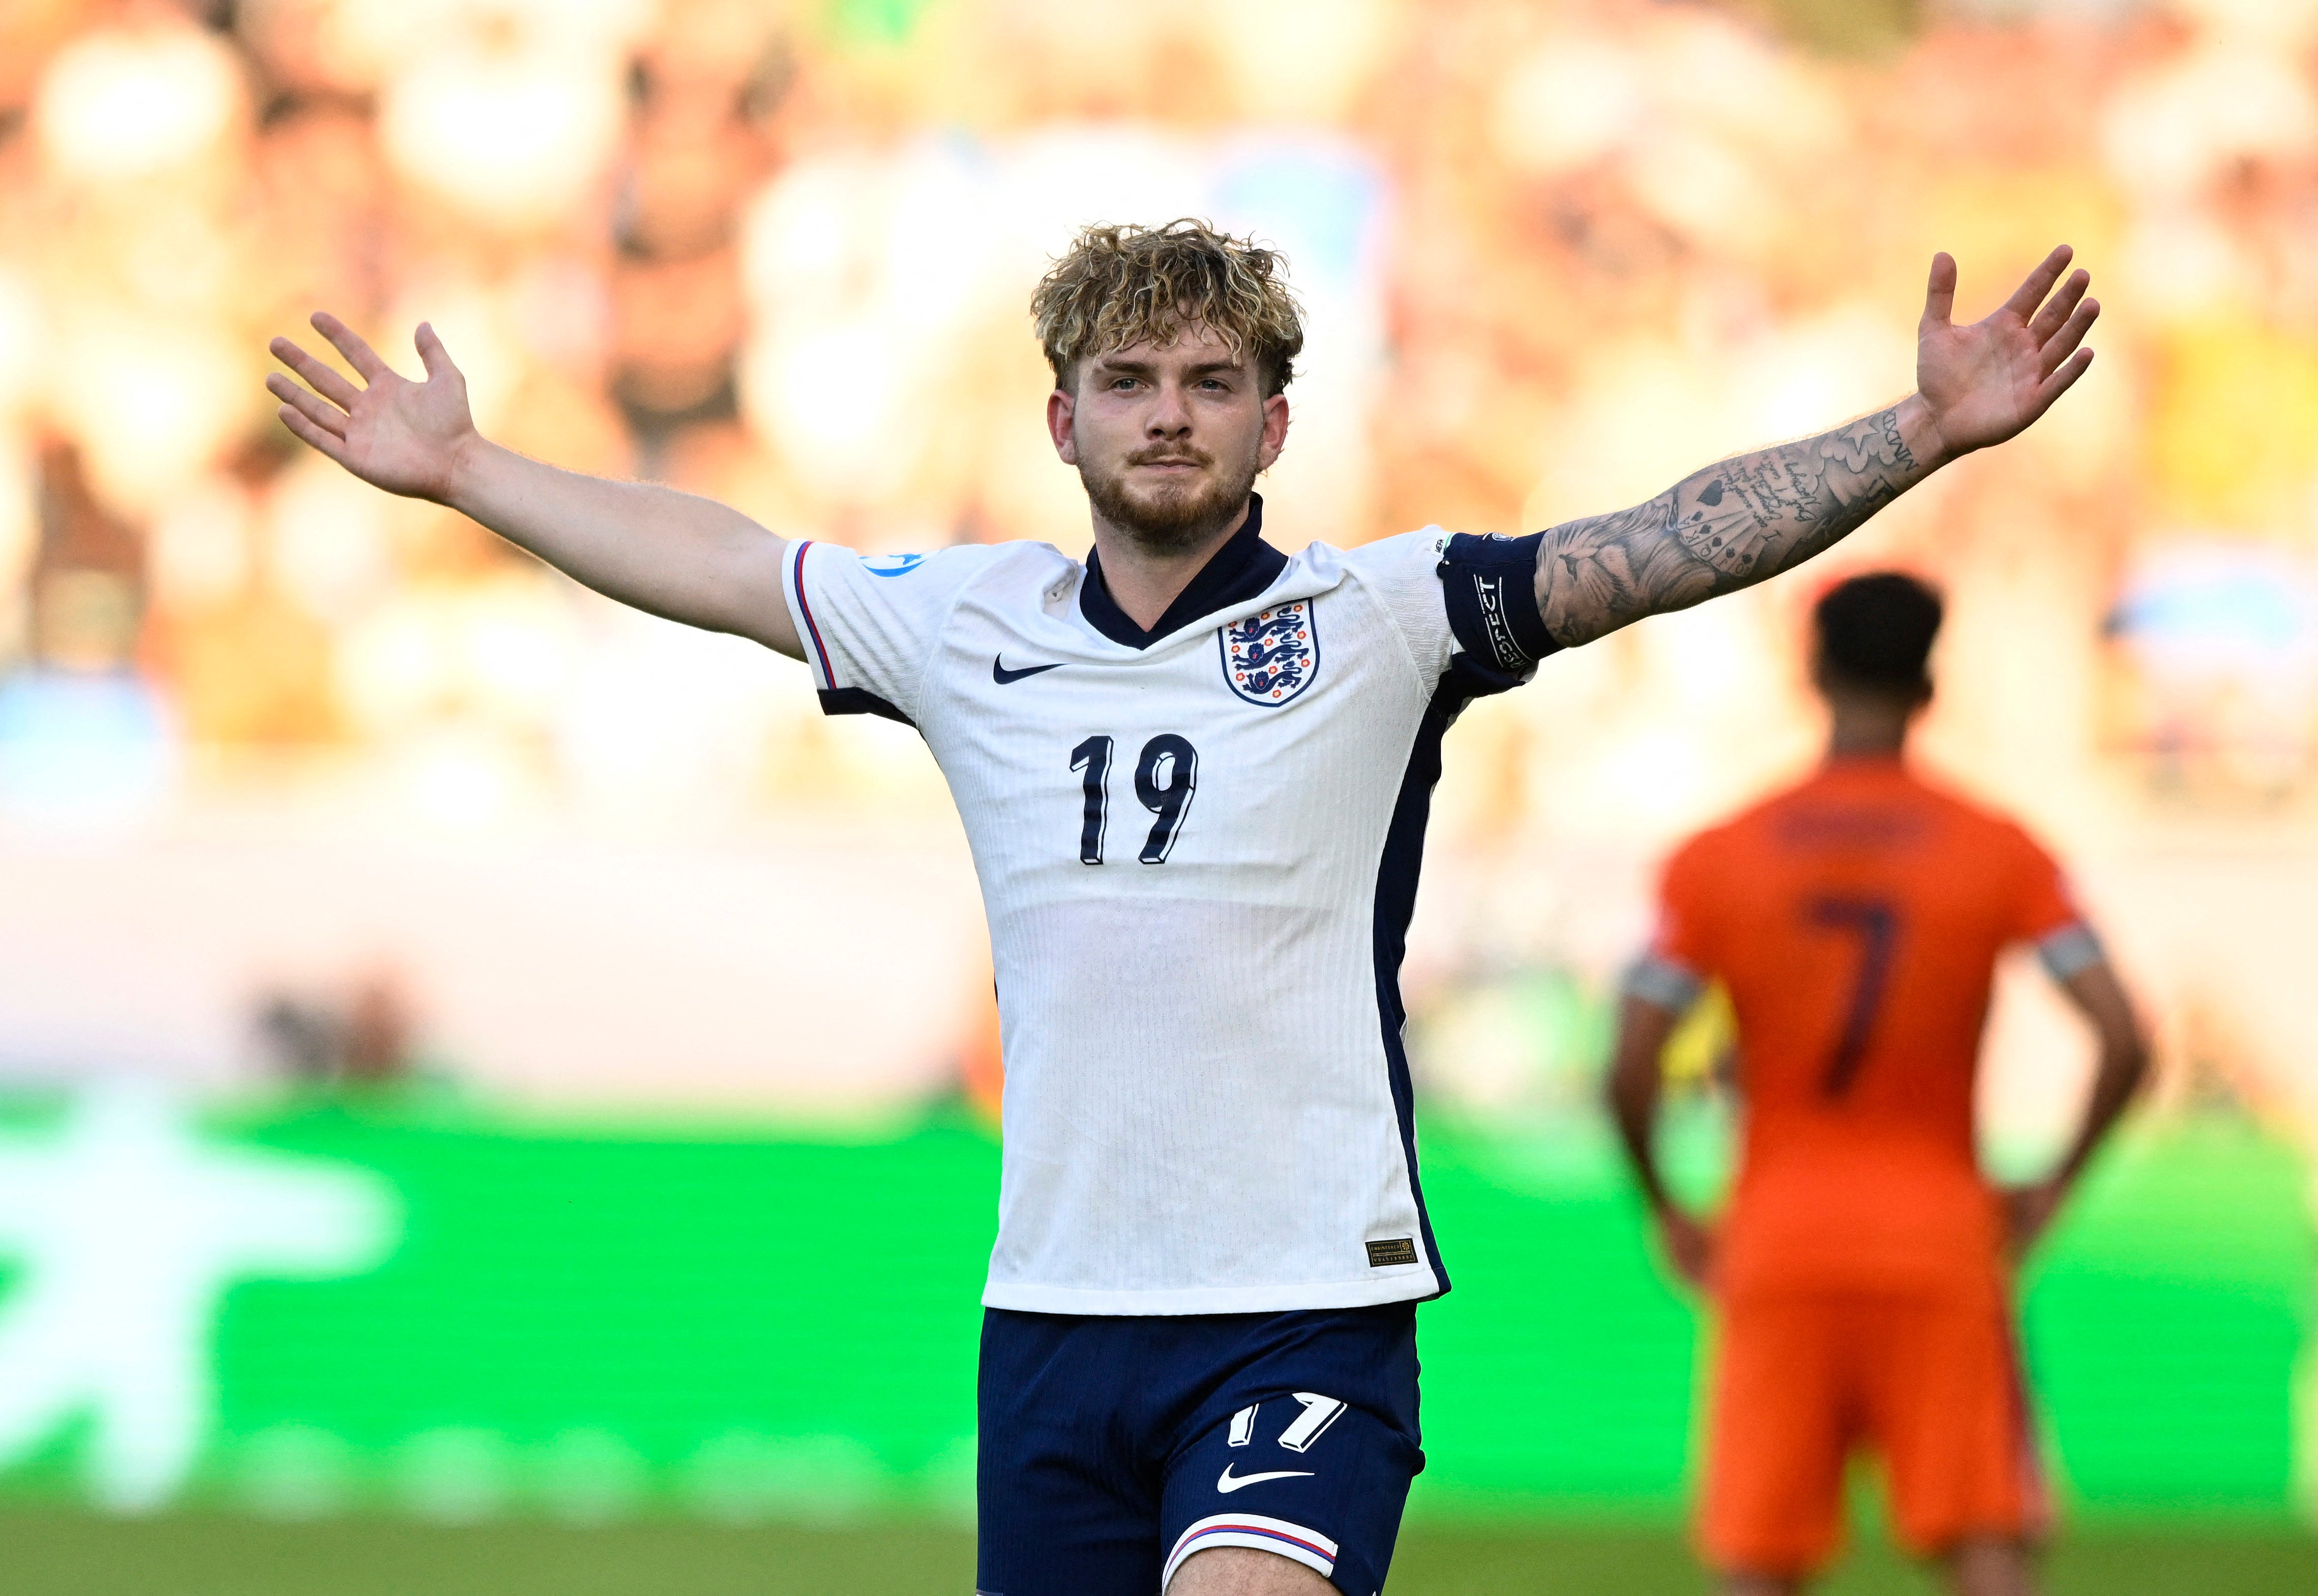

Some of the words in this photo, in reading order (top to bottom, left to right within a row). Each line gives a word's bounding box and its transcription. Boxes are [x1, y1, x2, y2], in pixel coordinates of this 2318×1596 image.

[1679, 515, 1690, 525] A
[1685, 530, 1700, 544] K
[1761, 529, 1781, 543] I
[1434, 538, 1444, 553] UEFA
[1700, 544, 1711, 557] Q
[1478, 576, 1527, 669] RESPECT
[1069, 734, 1198, 865] 19
[1795, 890, 1907, 1098] 7
